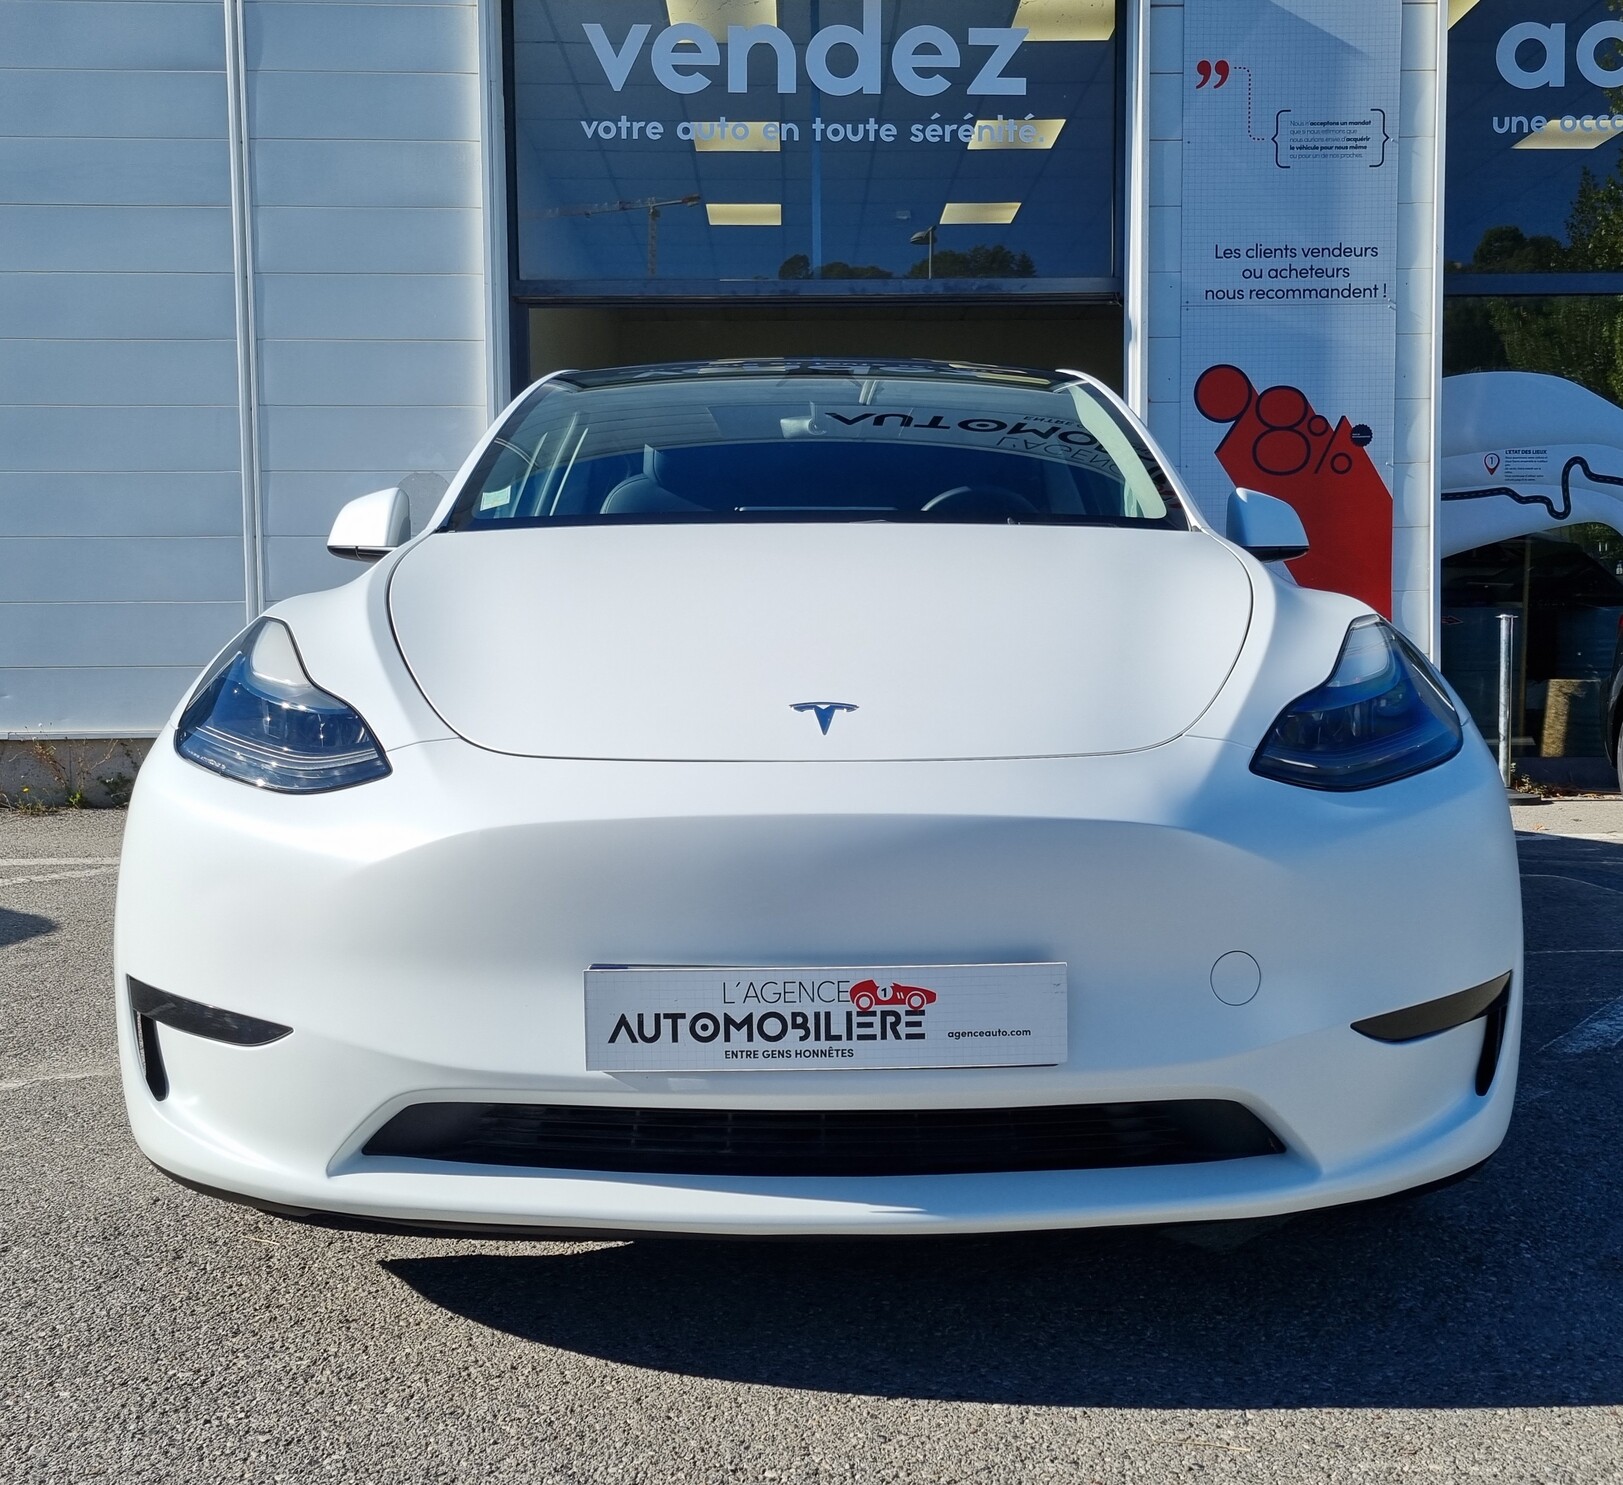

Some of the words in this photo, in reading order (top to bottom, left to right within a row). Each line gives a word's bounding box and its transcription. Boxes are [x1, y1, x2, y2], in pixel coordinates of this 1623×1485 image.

[581, 0, 1030, 97] vendez
[580, 115, 664, 141] votre
[676, 116, 750, 141] auto
[762, 122, 800, 141] en
[812, 117, 898, 143] toute
[910, 112, 1045, 143] sérénité.
[1492, 115, 1548, 134] une
[1215, 244, 1241, 259] Les
[1245, 243, 1297, 259] clients
[1302, 242, 1379, 258] vendeurs
[1242, 268, 1263, 279] ou
[1267, 263, 1350, 279] acheteurs
[1204, 289, 1245, 300] nous
[1249, 283, 1379, 300] recommandent
[1193, 364, 1353, 476] 98%
[722, 980, 851, 1004] L'AGENCE
[607, 1009, 926, 1044] AUTOMOBILIERE
[947, 1028, 1032, 1041] agenceauto.com
[724, 1050, 759, 1059] ENTRE
[762, 1050, 792, 1059] GENS
[794, 1046, 854, 1059] HONNÊTES
